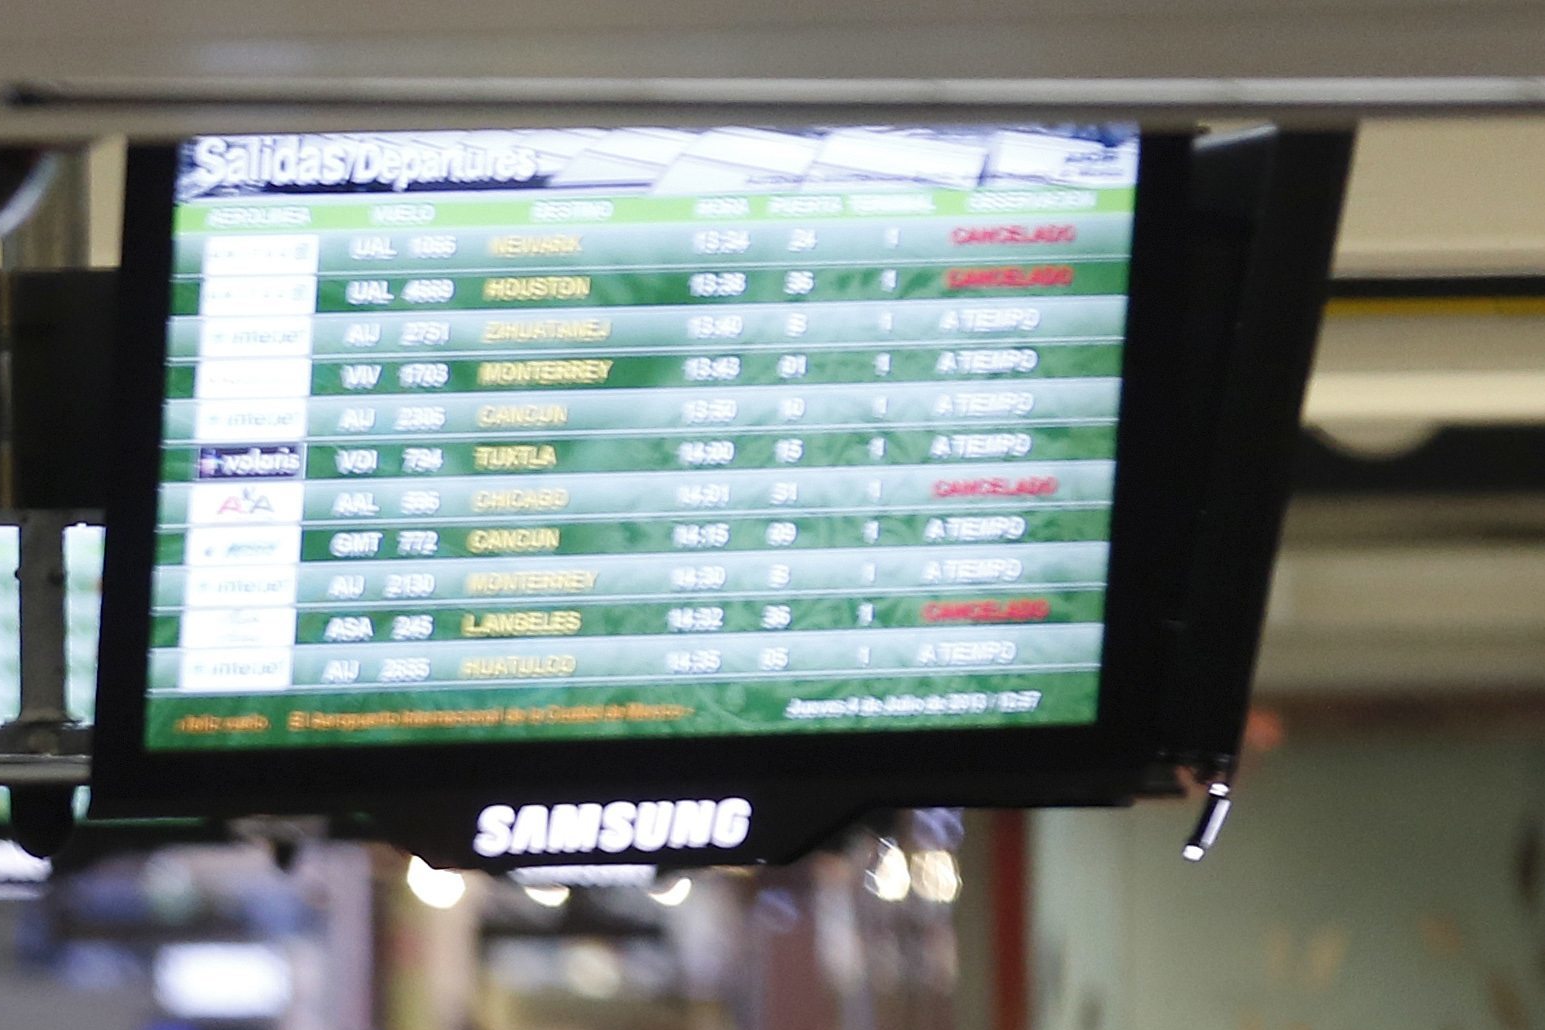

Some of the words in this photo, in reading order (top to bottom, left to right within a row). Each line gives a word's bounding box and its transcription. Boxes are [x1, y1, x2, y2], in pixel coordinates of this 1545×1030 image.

[489, 236, 582, 256] NEWARK
[949, 226, 1077, 246] CANCELADO
[483, 277, 590, 301] HOUSTON
[945, 266, 1074, 290] CANCELADO
[961, 308, 1041, 331] TIEMPO
[477, 360, 613, 386] MONTERREY
[957, 348, 1039, 374] TIEMPO
[478, 404, 567, 428] CANCUN
[954, 392, 1035, 417] TIEMPO
[952, 433, 1032, 457] TIEMPO
[222, 447, 300, 474] volaris
[474, 445, 556, 471] TUXTLA
[470, 489, 569, 511] CHICAGO
[931, 478, 1058, 498] CANCELADO
[946, 516, 1027, 541] TIEMPO
[466, 529, 560, 553] CANCUN
[943, 558, 1023, 582] TIEMPO
[464, 571, 598, 595] MONTERREY
[920, 600, 1051, 623] CANCELADO
[937, 640, 1017, 664] TIEMPO
[460, 656, 576, 680] HUATULCO
[472, 797, 752, 857] SAMSUNG
